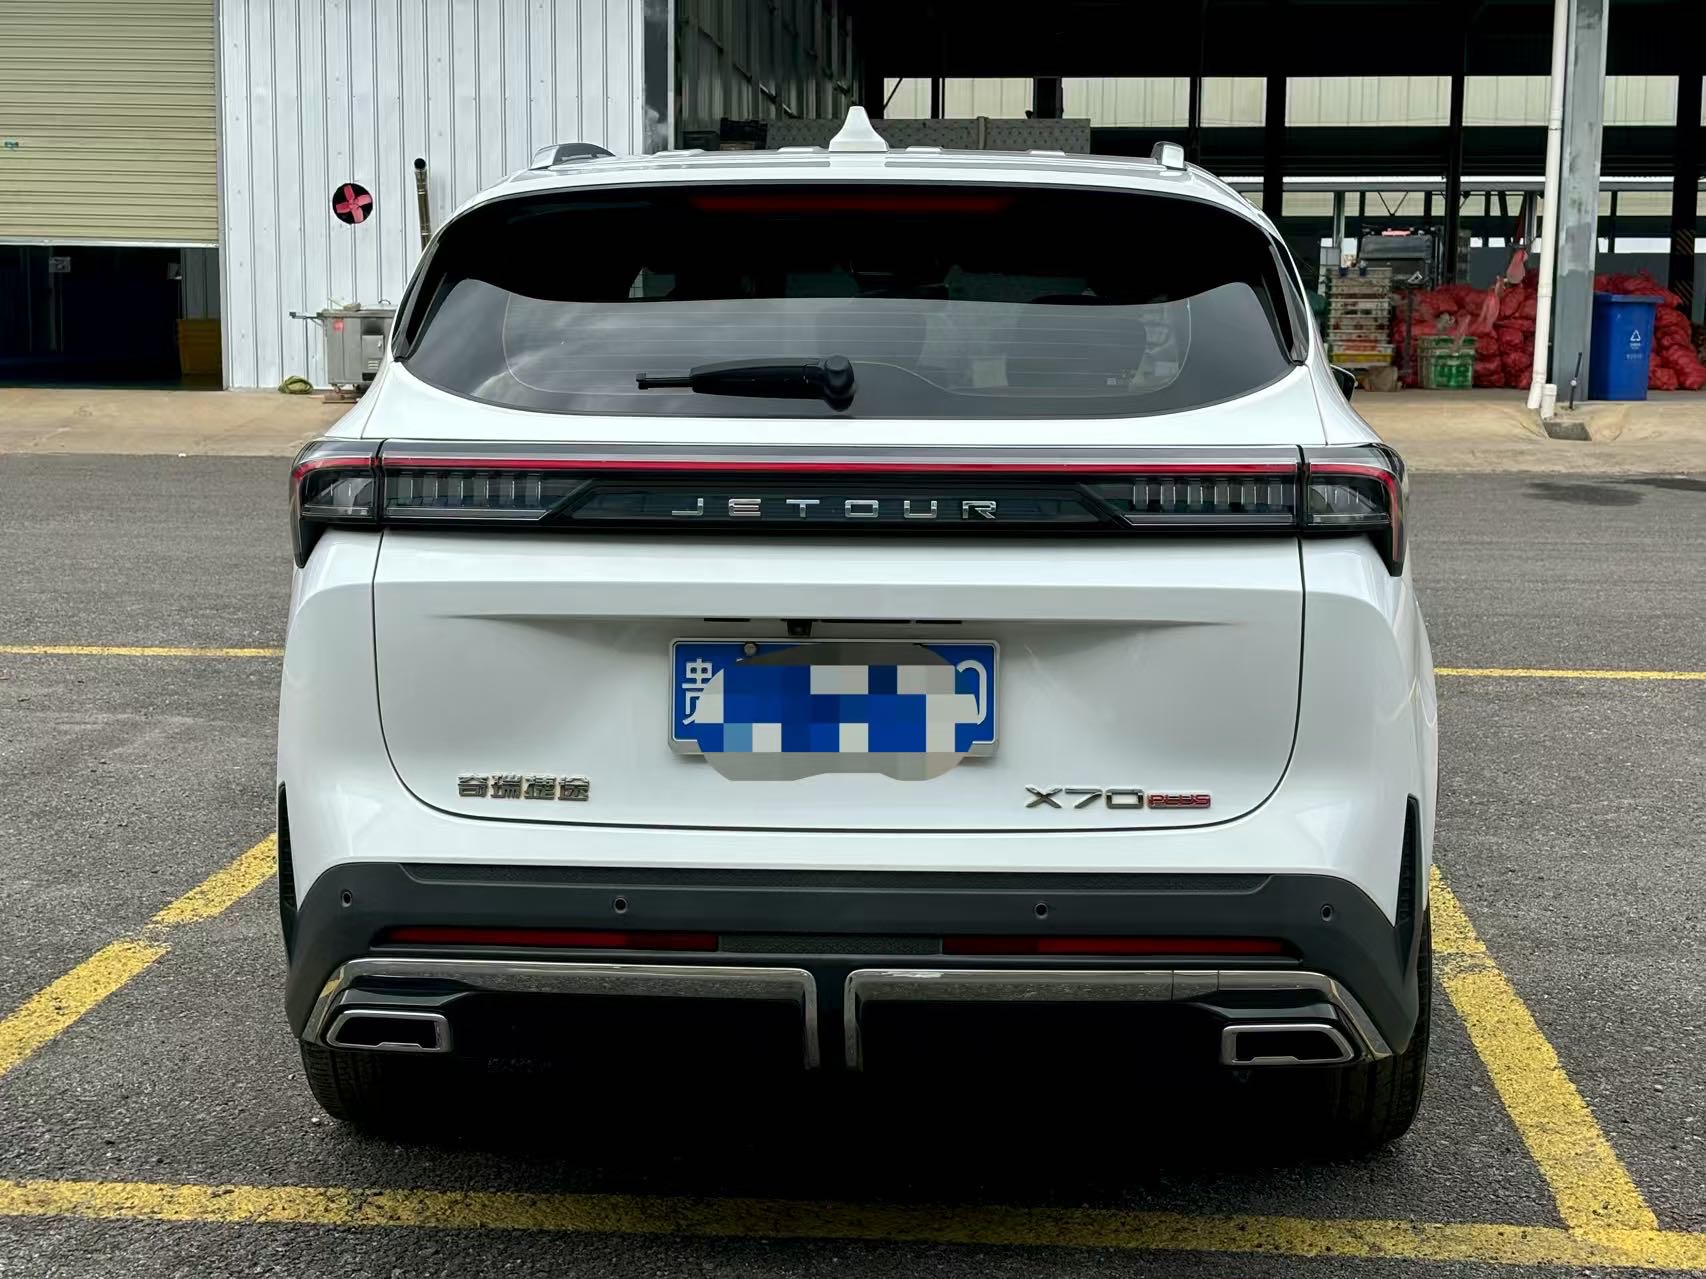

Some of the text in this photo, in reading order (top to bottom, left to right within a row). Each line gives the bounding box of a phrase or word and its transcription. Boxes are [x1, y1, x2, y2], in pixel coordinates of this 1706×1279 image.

[671, 498, 997, 519] JETOUR
[457, 775, 590, 801] 奇瑞捷途
